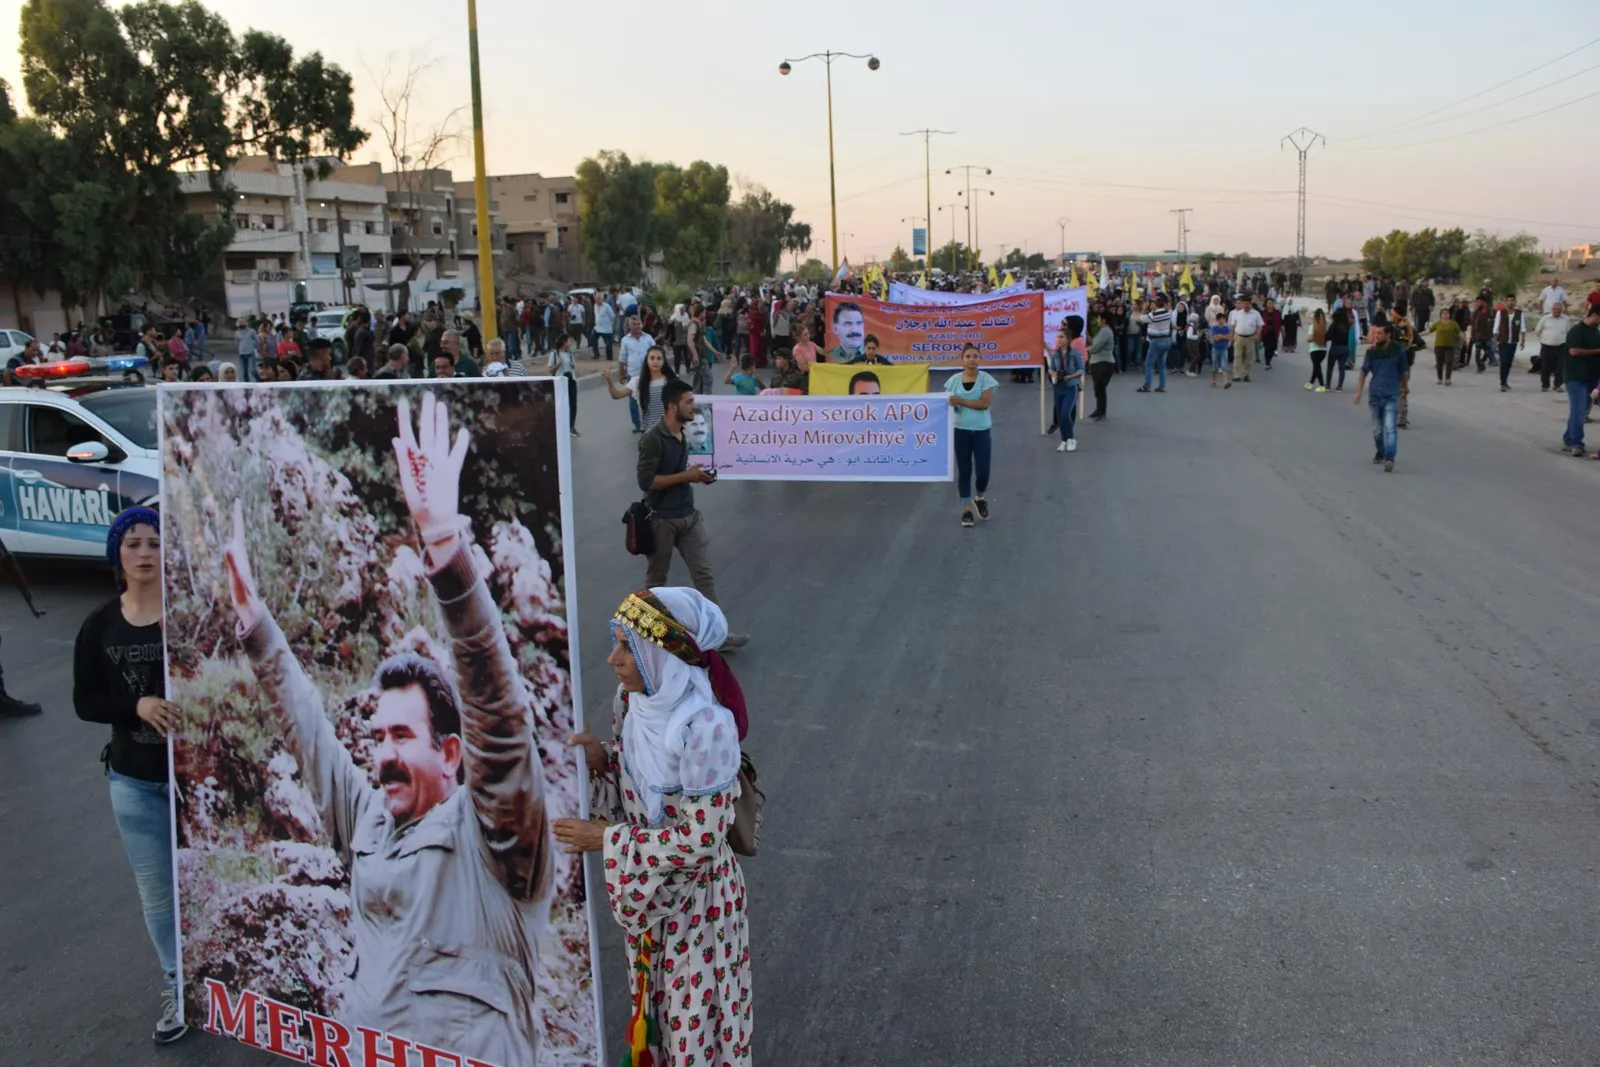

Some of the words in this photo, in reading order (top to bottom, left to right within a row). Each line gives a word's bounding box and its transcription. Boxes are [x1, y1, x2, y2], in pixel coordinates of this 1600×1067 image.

[933, 315, 951, 328] الله
[954, 318, 976, 330] عبد
[912, 342, 963, 353] SEROK
[732, 403, 815, 426] Azadiya
[820, 401, 878, 423] serok
[883, 402, 929, 423] APO
[728, 430, 798, 448] Azadiya
[803, 426, 906, 449] Mirovahiyê
[914, 431, 937, 449] ye
[784, 454, 815, 466] حرية
[897, 454, 928, 467] حرية
[18, 483, 111, 526] HAWARÎ
[203, 977, 505, 1067] MERH
